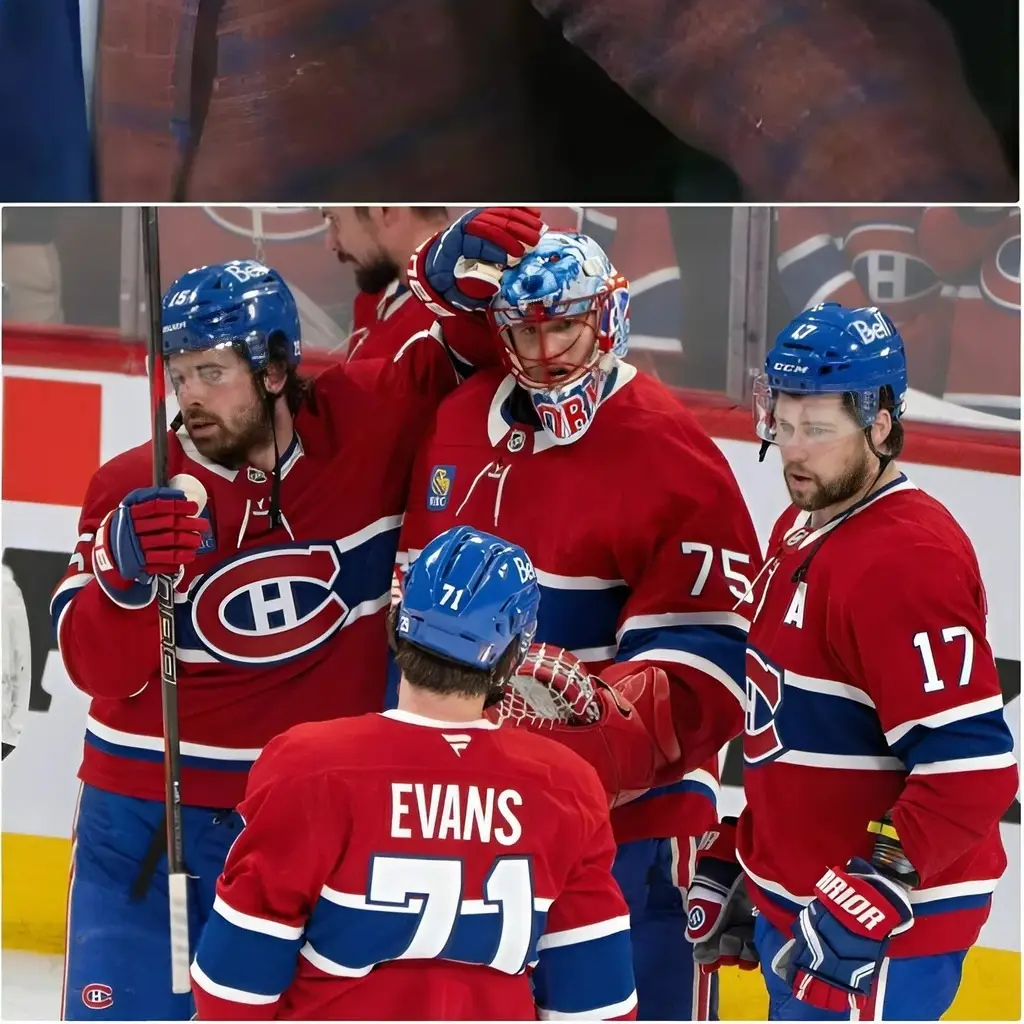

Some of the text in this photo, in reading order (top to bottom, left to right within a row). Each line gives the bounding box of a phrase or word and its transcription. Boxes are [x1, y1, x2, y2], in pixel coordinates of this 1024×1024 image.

[852, 311, 892, 345] Bell
[773, 362, 809, 374] CCM
[438, 582, 465, 611] 71
[680, 541, 755, 604] 75
[783, 580, 808, 629] A
[912, 625, 975, 694] 17
[390, 782, 524, 847] EVANS
[367, 853, 534, 976] 71
